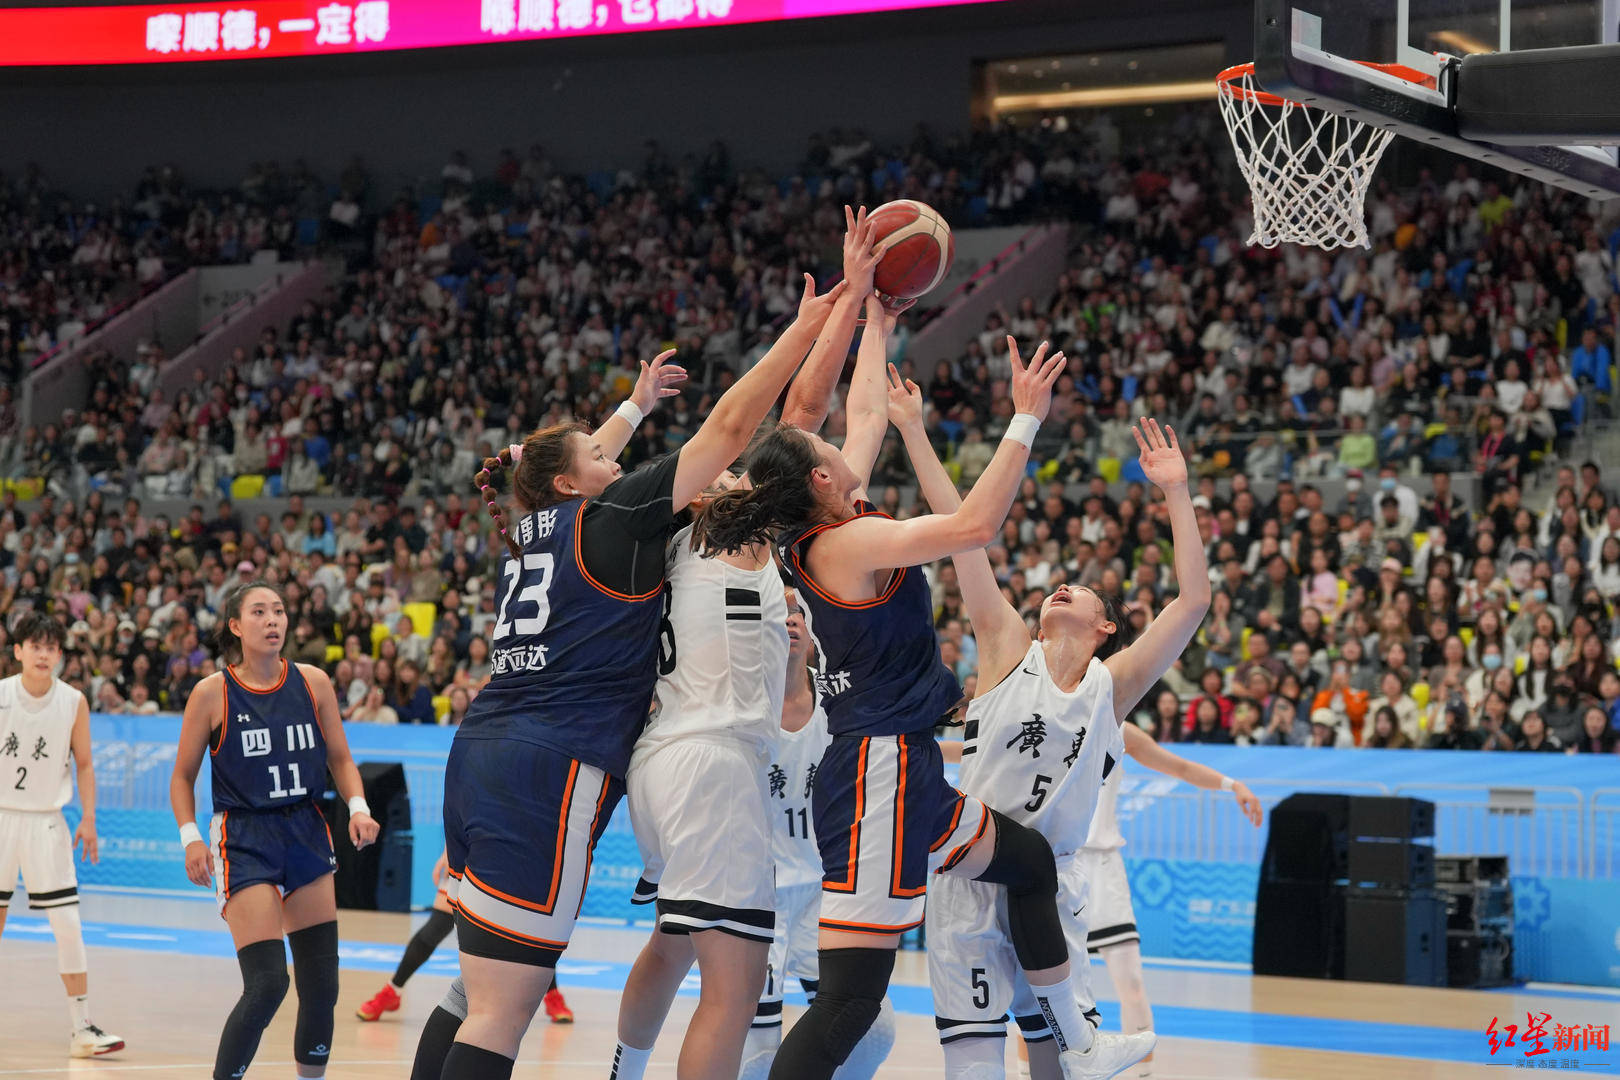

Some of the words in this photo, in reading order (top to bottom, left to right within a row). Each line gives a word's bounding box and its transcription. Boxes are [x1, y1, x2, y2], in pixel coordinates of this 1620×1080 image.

[493, 552, 554, 641] 23
[241, 723, 315, 757] 四川
[15, 766, 27, 790] 2
[268, 763, 307, 798] 11
[1024, 774, 1053, 812] 5
[784, 807, 808, 839] 11
[971, 967, 990, 1010] 5
